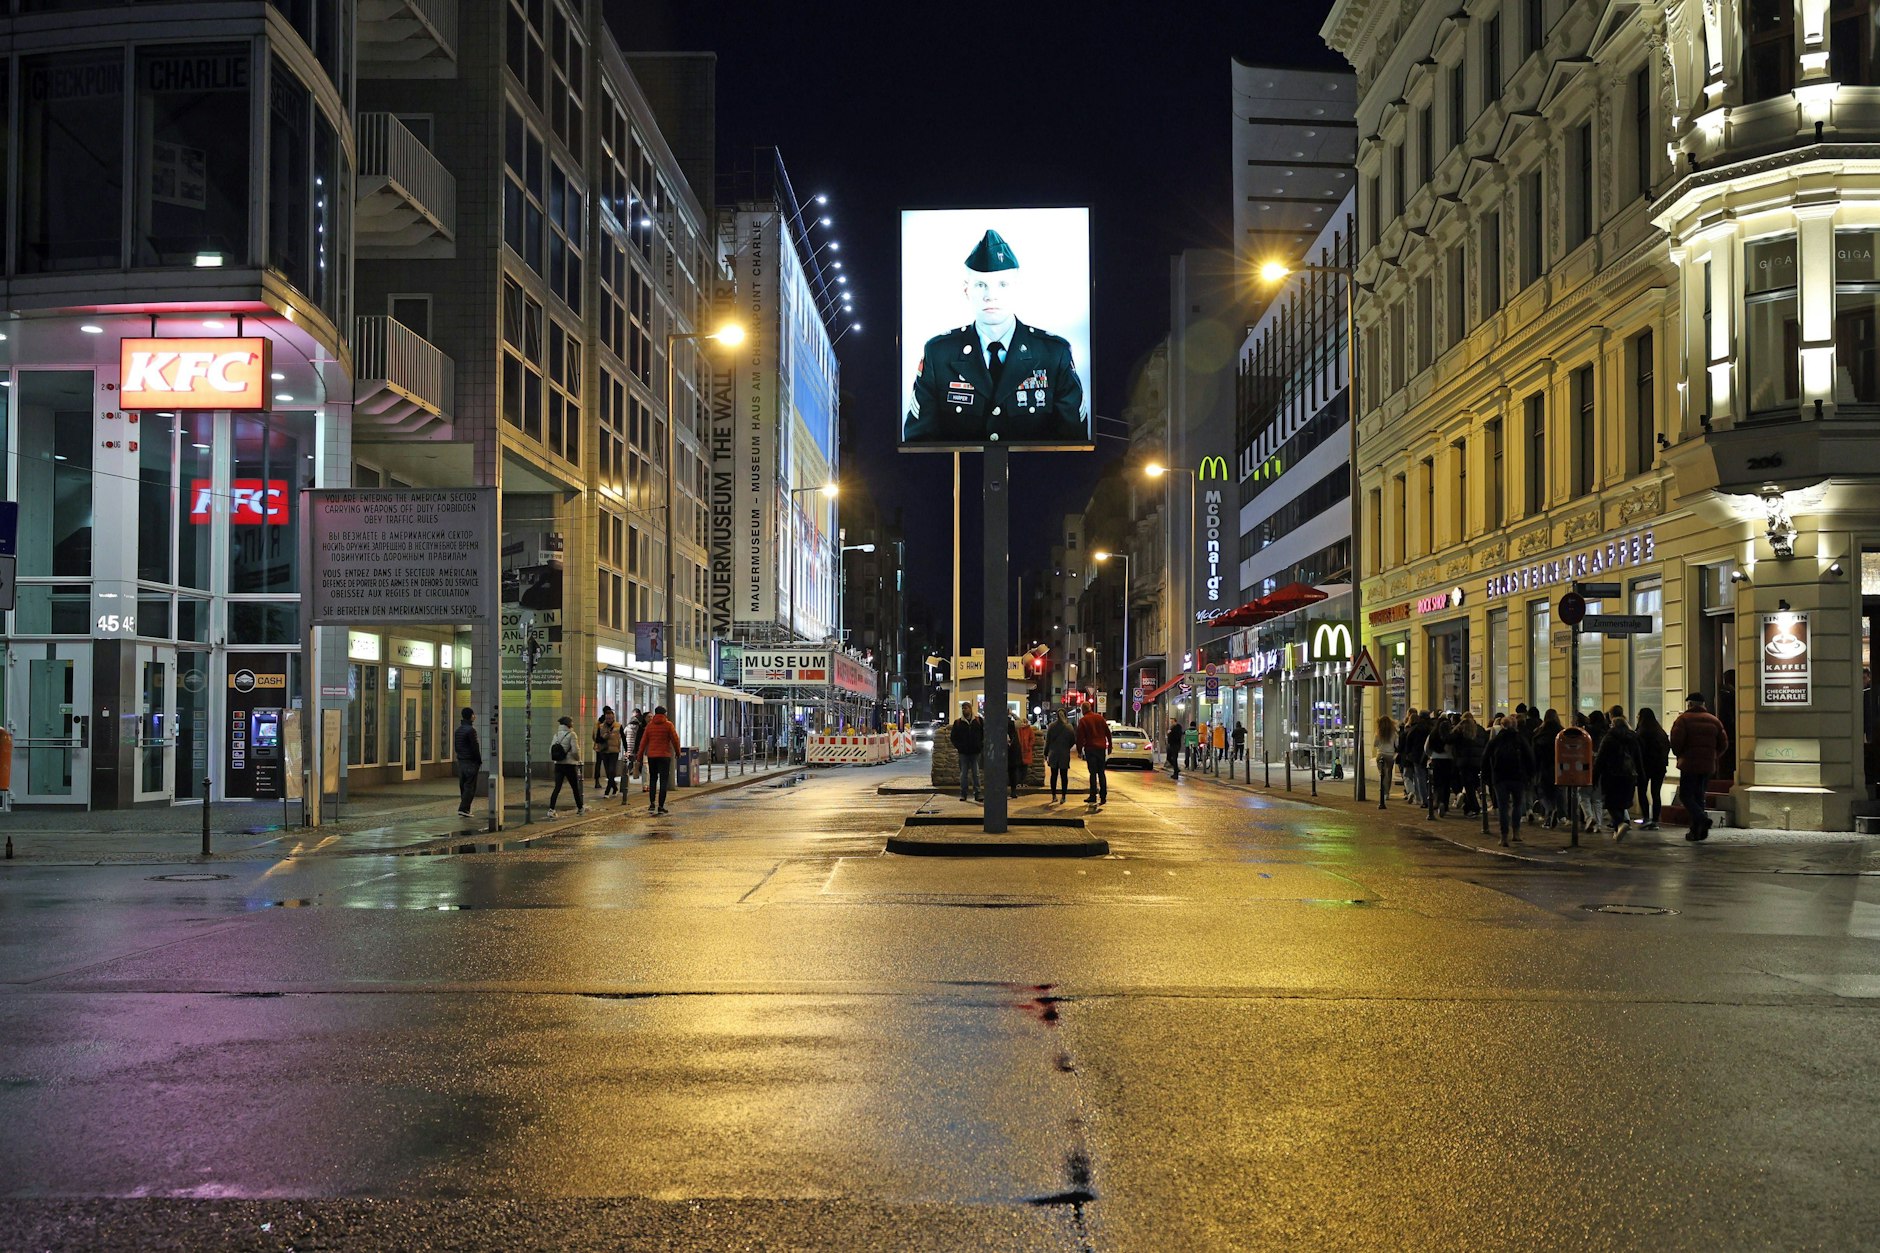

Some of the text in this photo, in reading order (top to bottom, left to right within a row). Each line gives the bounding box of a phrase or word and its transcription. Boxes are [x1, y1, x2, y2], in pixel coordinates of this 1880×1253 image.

[32, 65, 124, 99] CHECKPOIN
[149, 57, 247, 90] CHARLIE
[752, 220, 762, 276] CHARLIE
[1838, 250, 1871, 259] GIGA
[752, 283, 762, 366] CHECKPOINT
[122, 352, 250, 392] KFC
[752, 371, 761, 391] AM
[714, 367, 732, 422] WALL
[751, 395, 761, 430] HAUS
[714, 427, 731, 462] THE
[751, 435, 760, 492] MUSEUM
[325, 493, 477, 503] YOU ARE ENTERING THE AMERICAN SECTOR
[325, 504, 476, 514] CARRYING WEAPONS OFF DUTY FORBIDDEN
[364, 515, 438, 524] OBEY TRAFFIC RULES
[328, 532, 340, 541] ВЫ
[381, 532, 386, 541] В
[448, 532, 473, 541] СЕКТОР
[322, 542, 345, 551] НОСИТЬ
[346, 542, 370, 551] ОРУЖИЕ
[408, 542, 413, 551] В
[459, 542, 479, 551] ВРЕМЯ
[1205, 490, 1223, 600] McDonald's
[383, 553, 424, 562] ДОРОЖНЫМ
[428, 553, 467, 562] ПРАВИЛАМ
[713, 472, 732, 636] MAUERMUSEUM
[751, 509, 760, 612] MAUERMUSEUM
[1486, 533, 1655, 600] EINSTEIN KAFFEE
[323, 568, 341, 577] VOUS
[345, 568, 370, 577] ENTREZ
[373, 568, 392, 577] DANS
[395, 568, 402, 577] LE
[405, 568, 435, 577] SECTEUR
[348, 579, 355, 588] DE
[356, 579, 377, 588] PORTER
[378, 579, 389, 588] DES
[390, 579, 410, 588] ARMES
[411, 579, 419, 588] EN
[420, 579, 443, 588] DEHORS
[445, 579, 453, 588] DU
[455, 579, 479, 588] SERVICE
[368, 588, 382, 598] AUX
[413, 588, 422, 598] DE
[425, 588, 469, 598] CIRCULATION
[323, 605, 477, 616] SIE BETRETEN DEN AMERIKANISCHEN SEKTOR
[97, 615, 119, 631] 45
[544, 613, 554, 623] IN
[1593, 619, 1641, 629] Zimmerstraße
[745, 656, 826, 668] MUSEUM
[966, 662, 983, 670] ARMY
